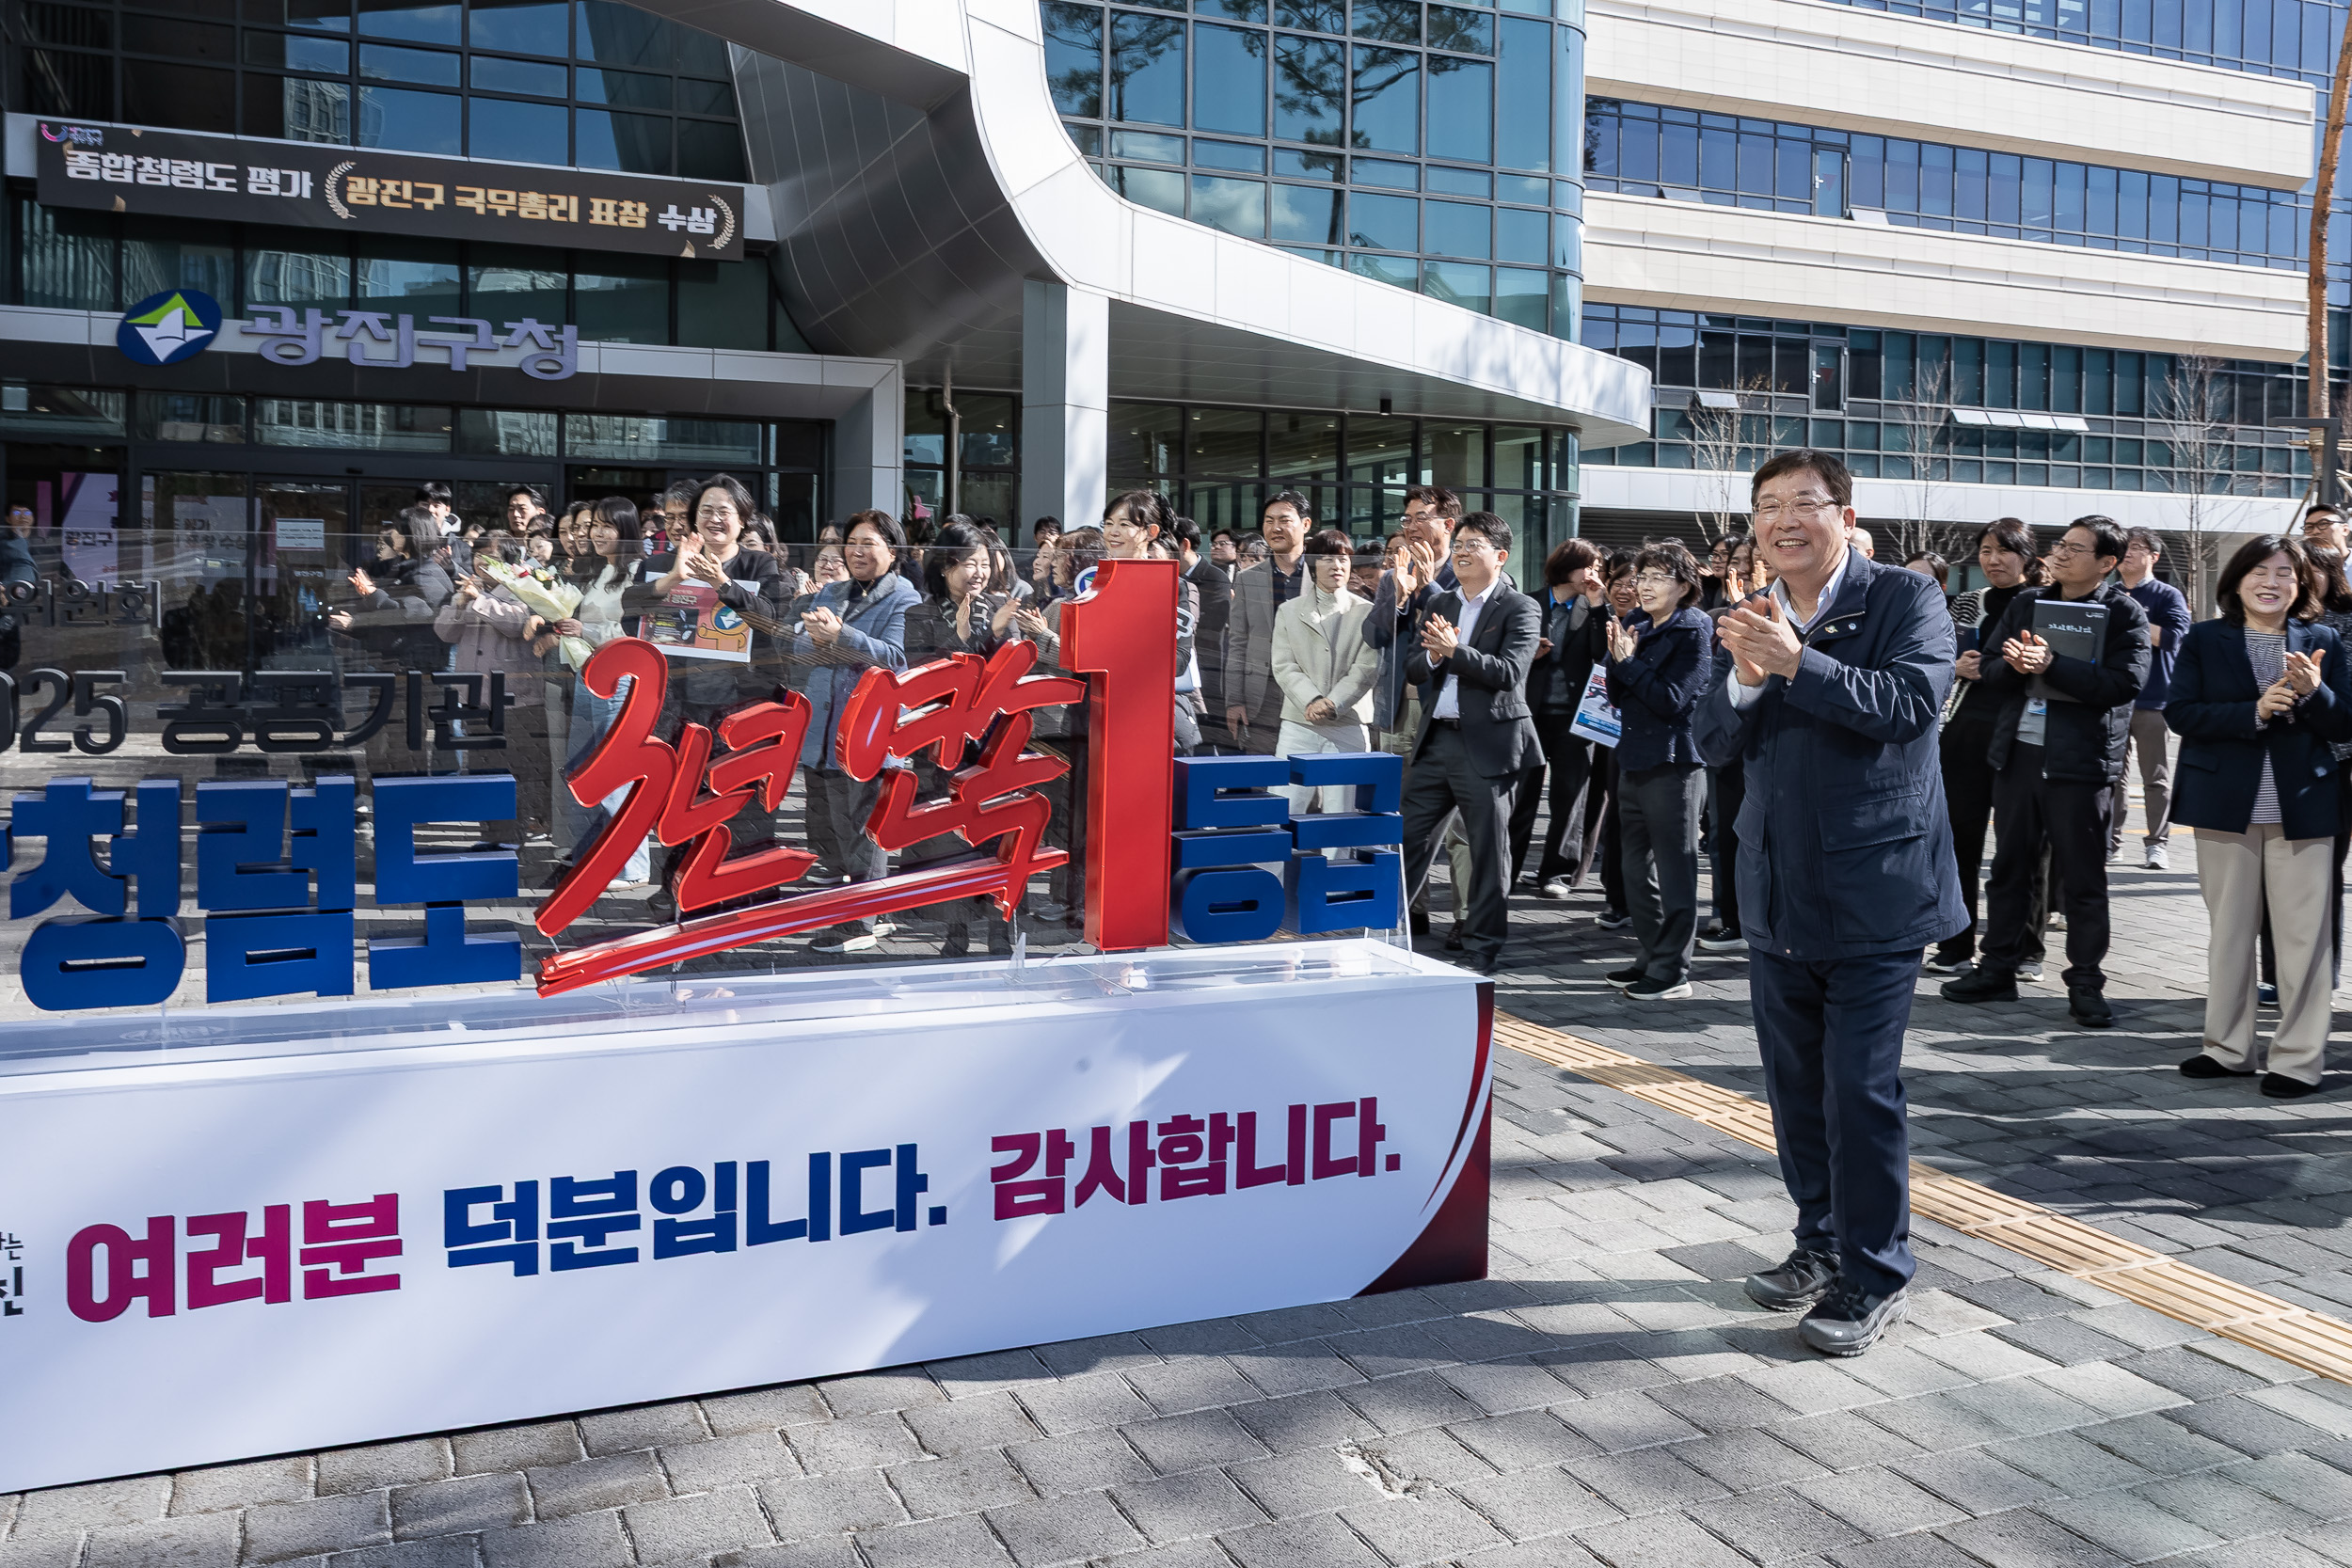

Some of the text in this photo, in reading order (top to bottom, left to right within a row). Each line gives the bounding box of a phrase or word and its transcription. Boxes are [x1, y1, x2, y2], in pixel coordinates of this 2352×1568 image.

[66, 150, 718, 235] 종합청렴도 평가 광진구 국무총리 표창 수상
[240, 304, 579, 381] 광진구청
[156, 669, 516, 753] 공공기관
[0, 775, 522, 1011] 청렴도
[835, 638, 1088, 923] 연속
[66, 1096, 1402, 1323] 여러분 덕분입니다. 감사합니다.
